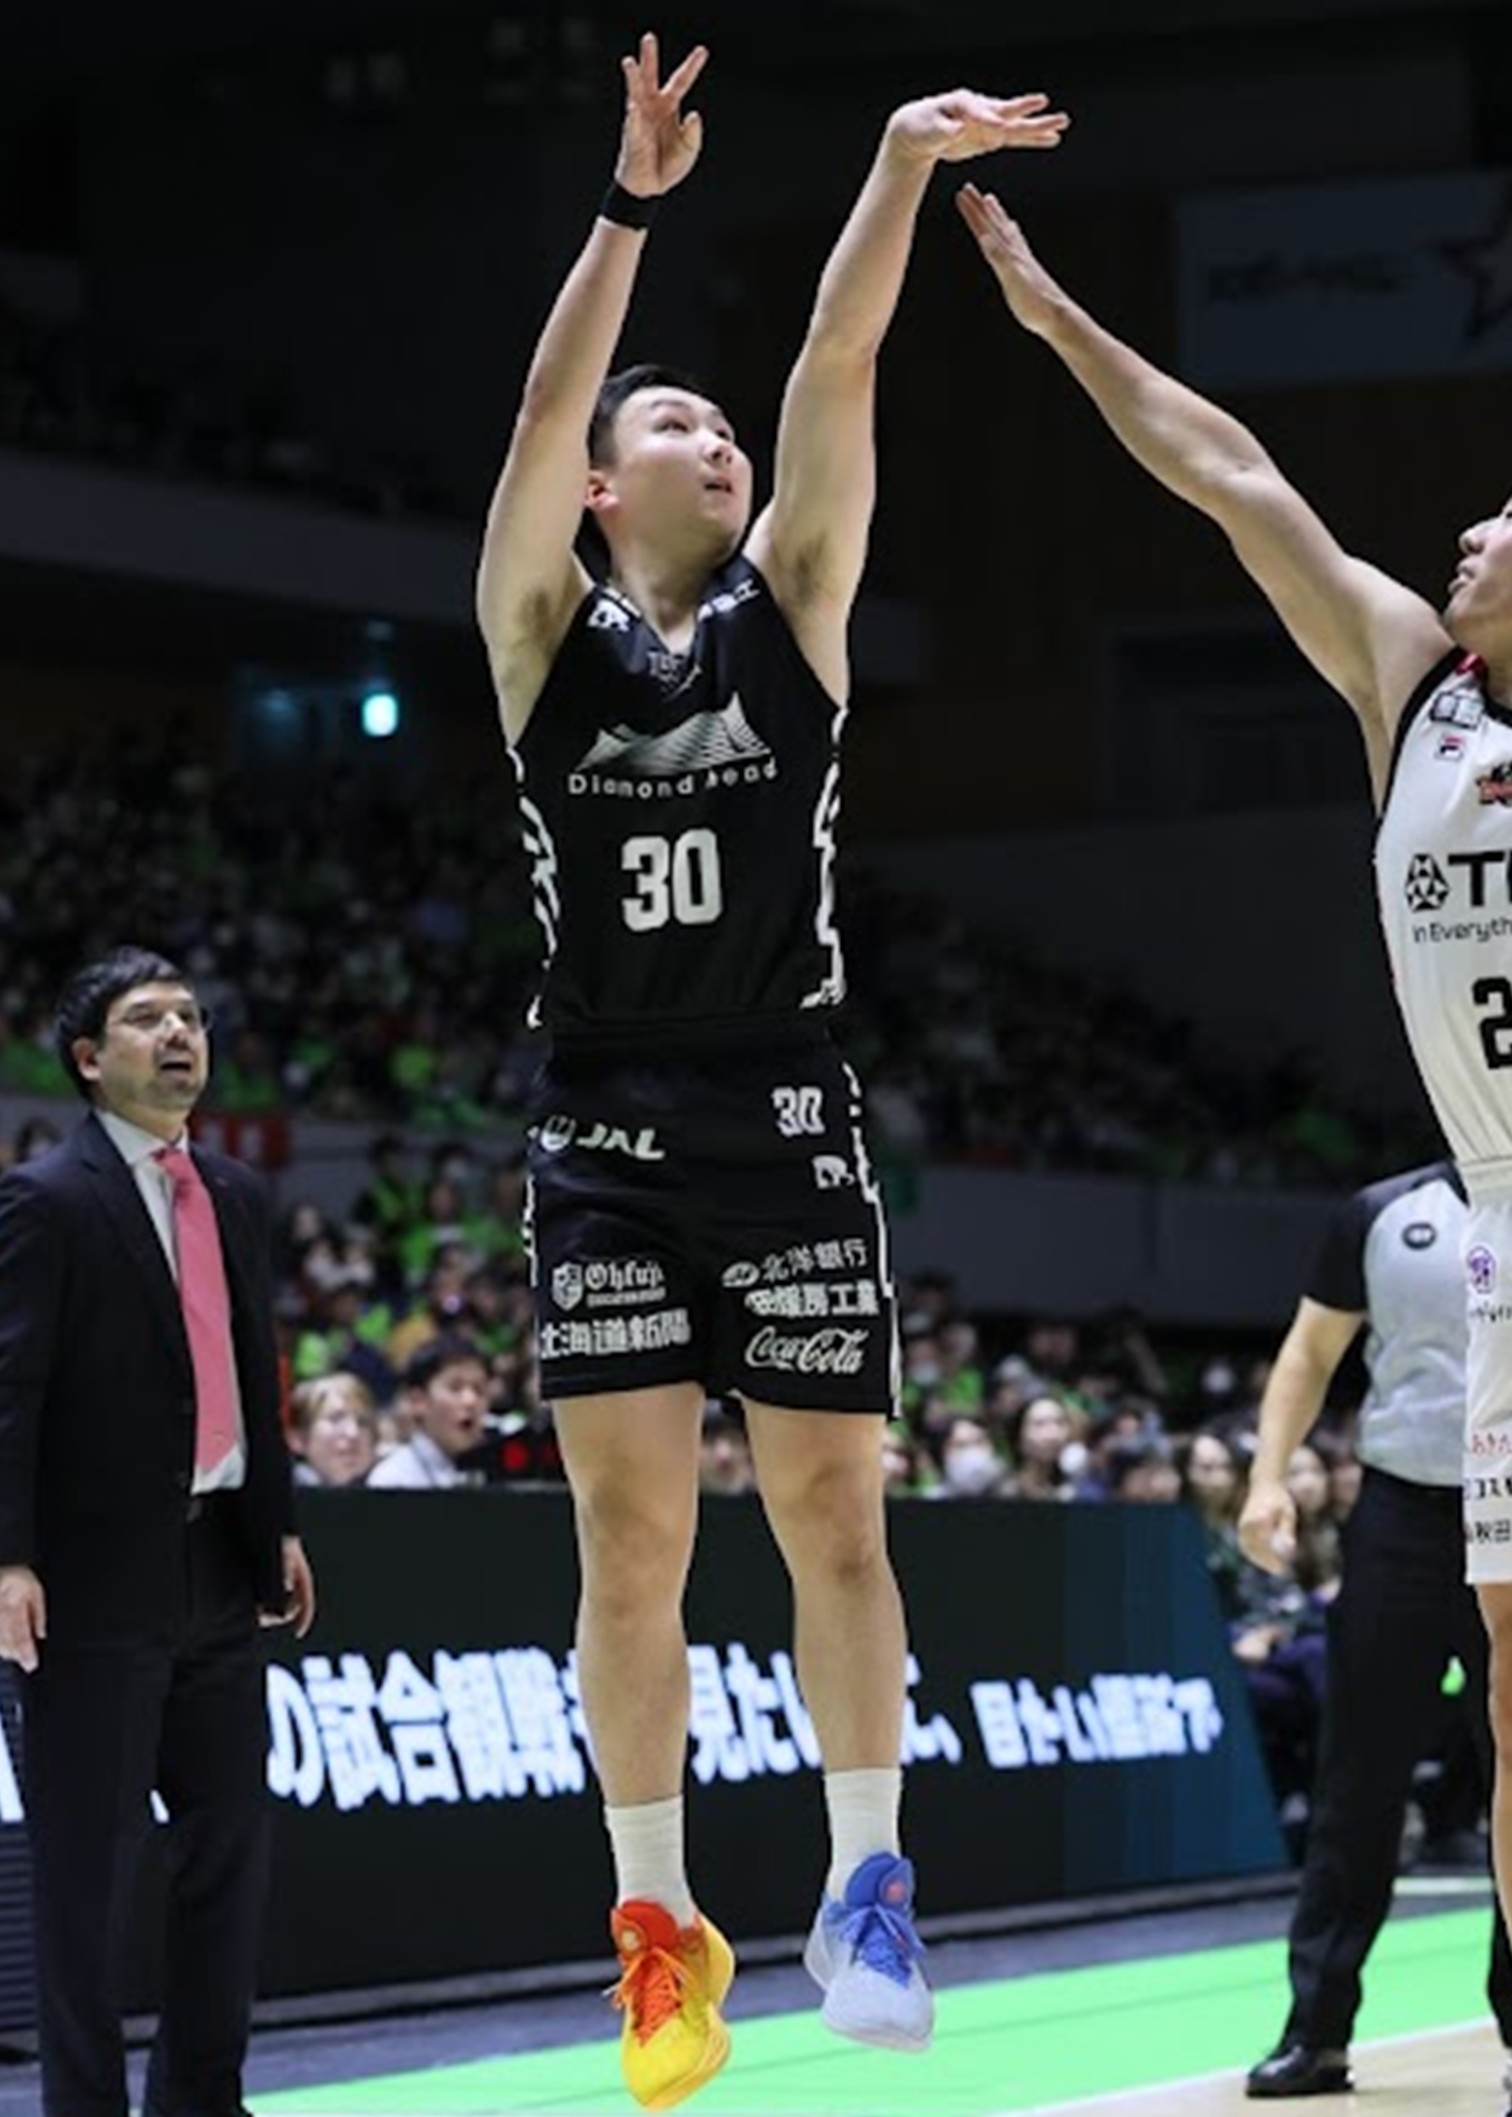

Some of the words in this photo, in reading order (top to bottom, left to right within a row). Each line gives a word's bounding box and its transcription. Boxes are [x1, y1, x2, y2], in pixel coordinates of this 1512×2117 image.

[568, 774, 694, 799] Diamond
[621, 827, 722, 932] 30
[1447, 850, 1512, 908] T
[771, 1086, 826, 1137] 30
[576, 1124, 665, 1160] JAL
